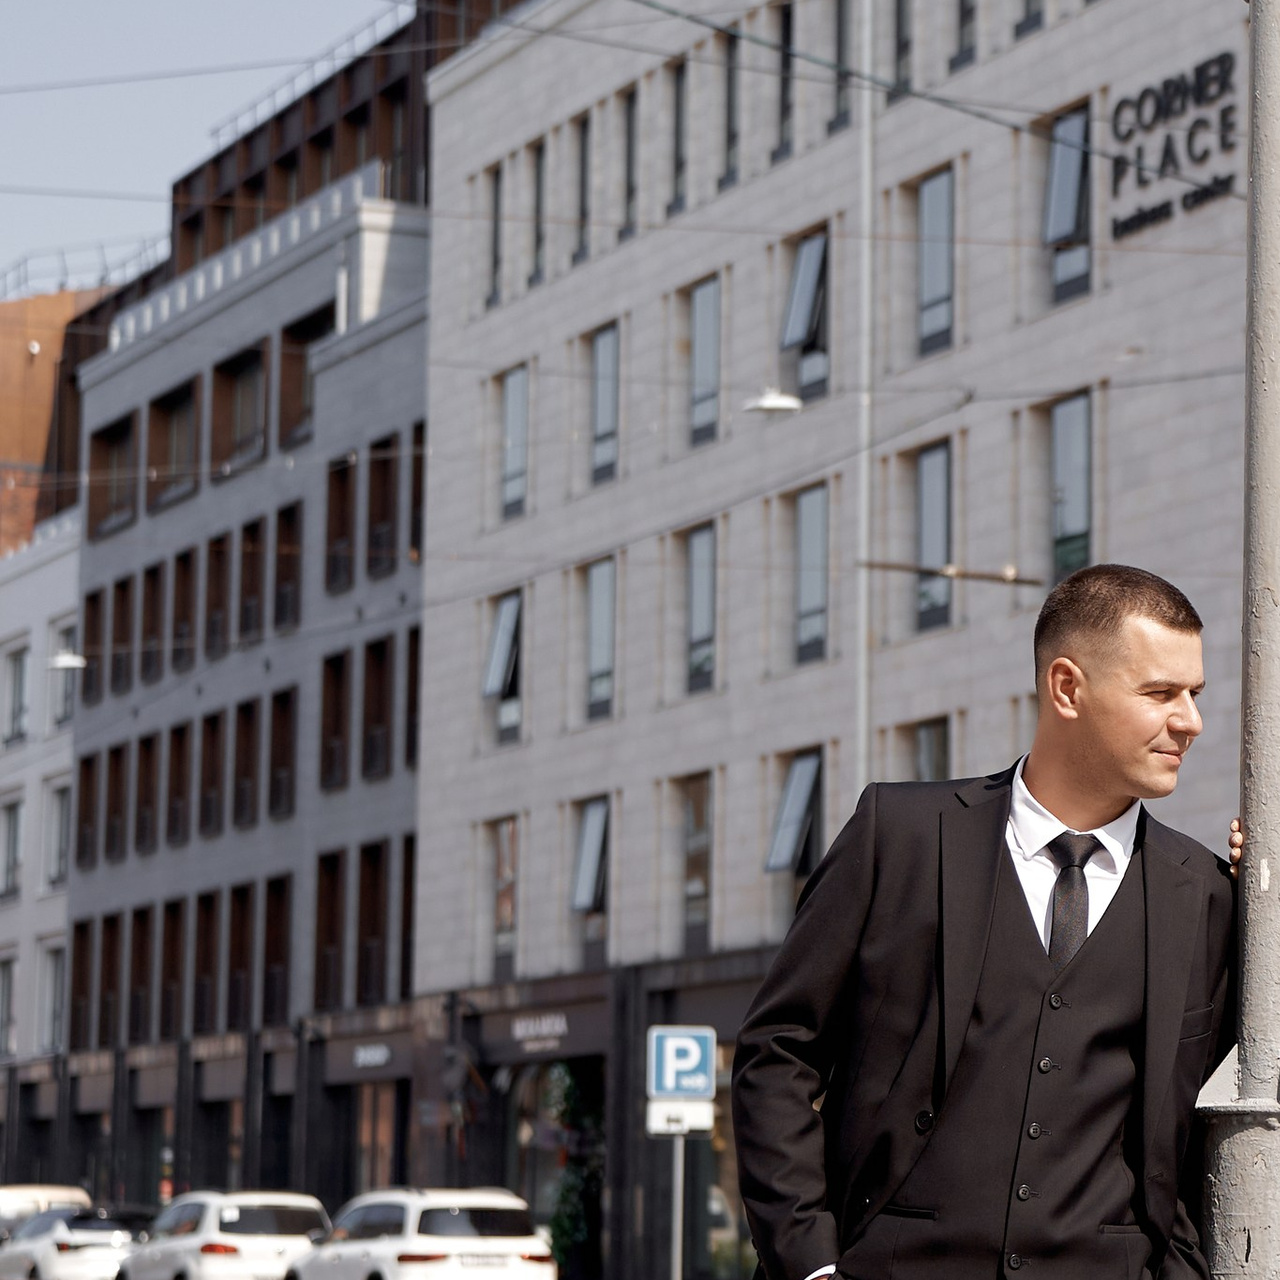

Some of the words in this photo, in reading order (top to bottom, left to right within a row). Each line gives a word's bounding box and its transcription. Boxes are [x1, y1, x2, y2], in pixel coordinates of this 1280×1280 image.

[1112, 52, 1236, 141] CORNER
[1112, 104, 1236, 198] PLACE
[664, 1036, 702, 1091] P
